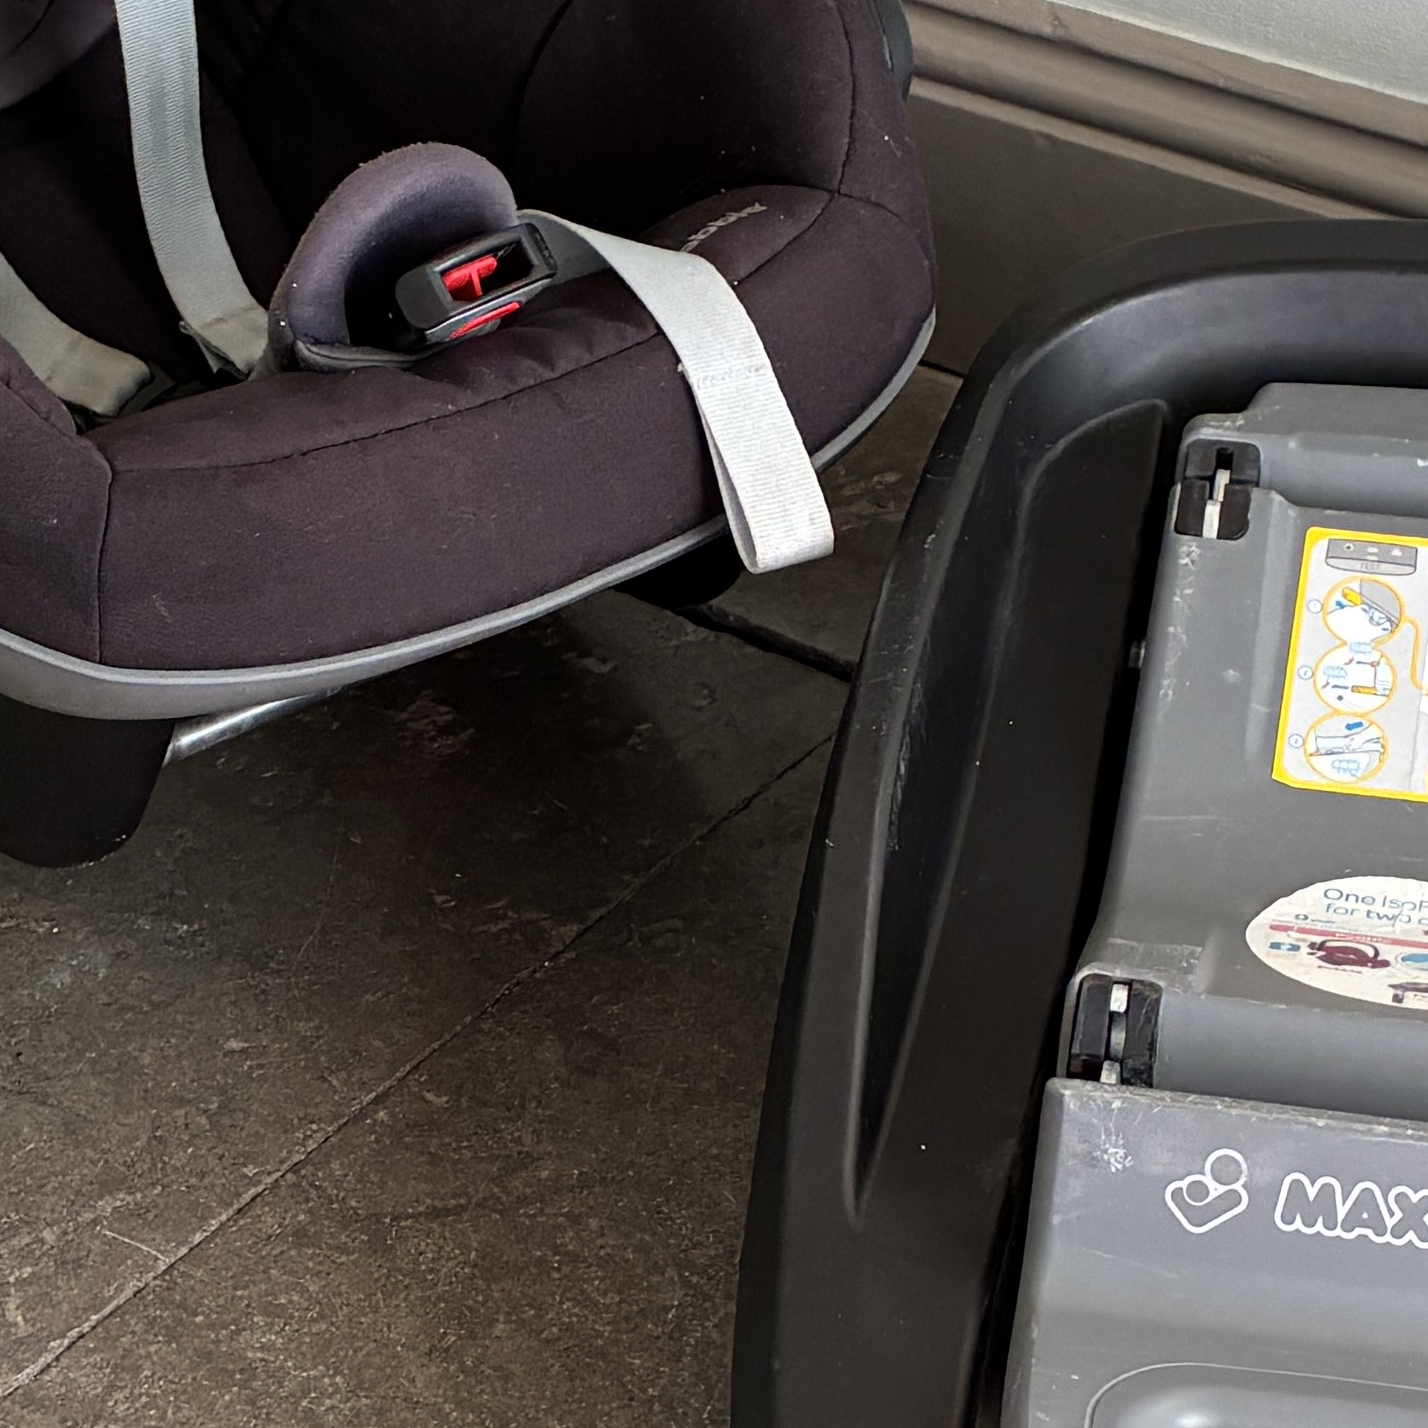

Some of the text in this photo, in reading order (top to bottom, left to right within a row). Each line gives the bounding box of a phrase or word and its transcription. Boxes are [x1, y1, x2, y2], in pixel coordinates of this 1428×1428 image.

[1323, 888, 1376, 906] One
[1325, 902, 1360, 916] for
[1366, 909, 1412, 924] two
